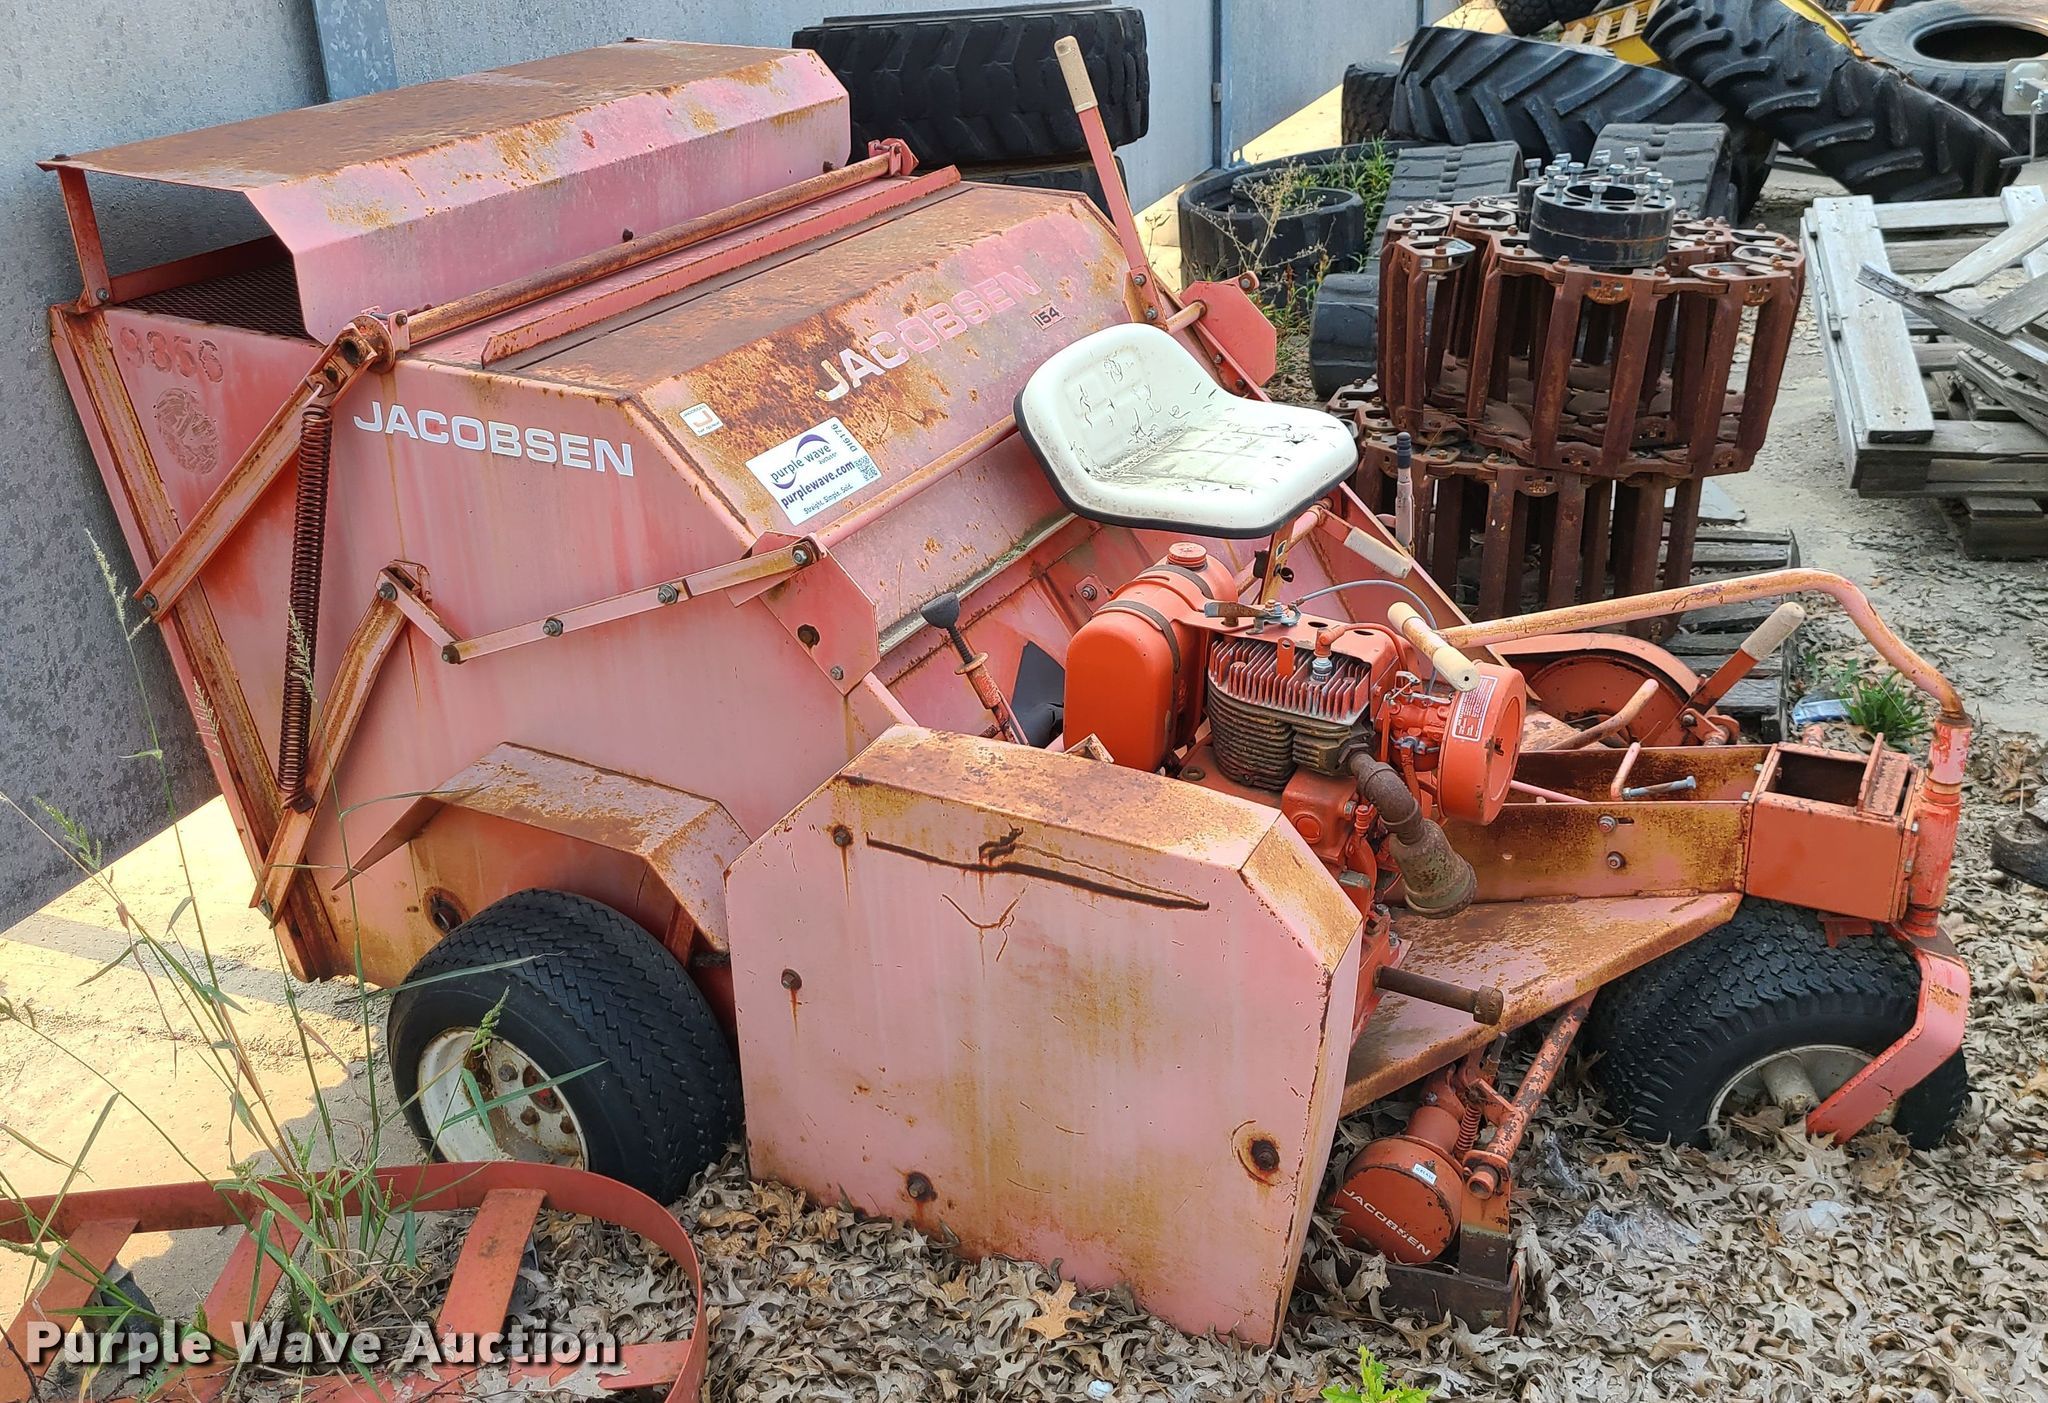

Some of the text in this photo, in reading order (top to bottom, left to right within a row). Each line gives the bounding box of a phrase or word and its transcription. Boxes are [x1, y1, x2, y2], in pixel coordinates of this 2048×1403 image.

[814, 264, 1042, 402] JACOBSEN
[1034, 308, 1062, 328] 154
[353, 401, 635, 477] JACOBSEN
[769, 443, 832, 482] purple wave
[780, 460, 856, 509] purplewave.com
[1342, 1188, 1431, 1256] JACOBSEN
